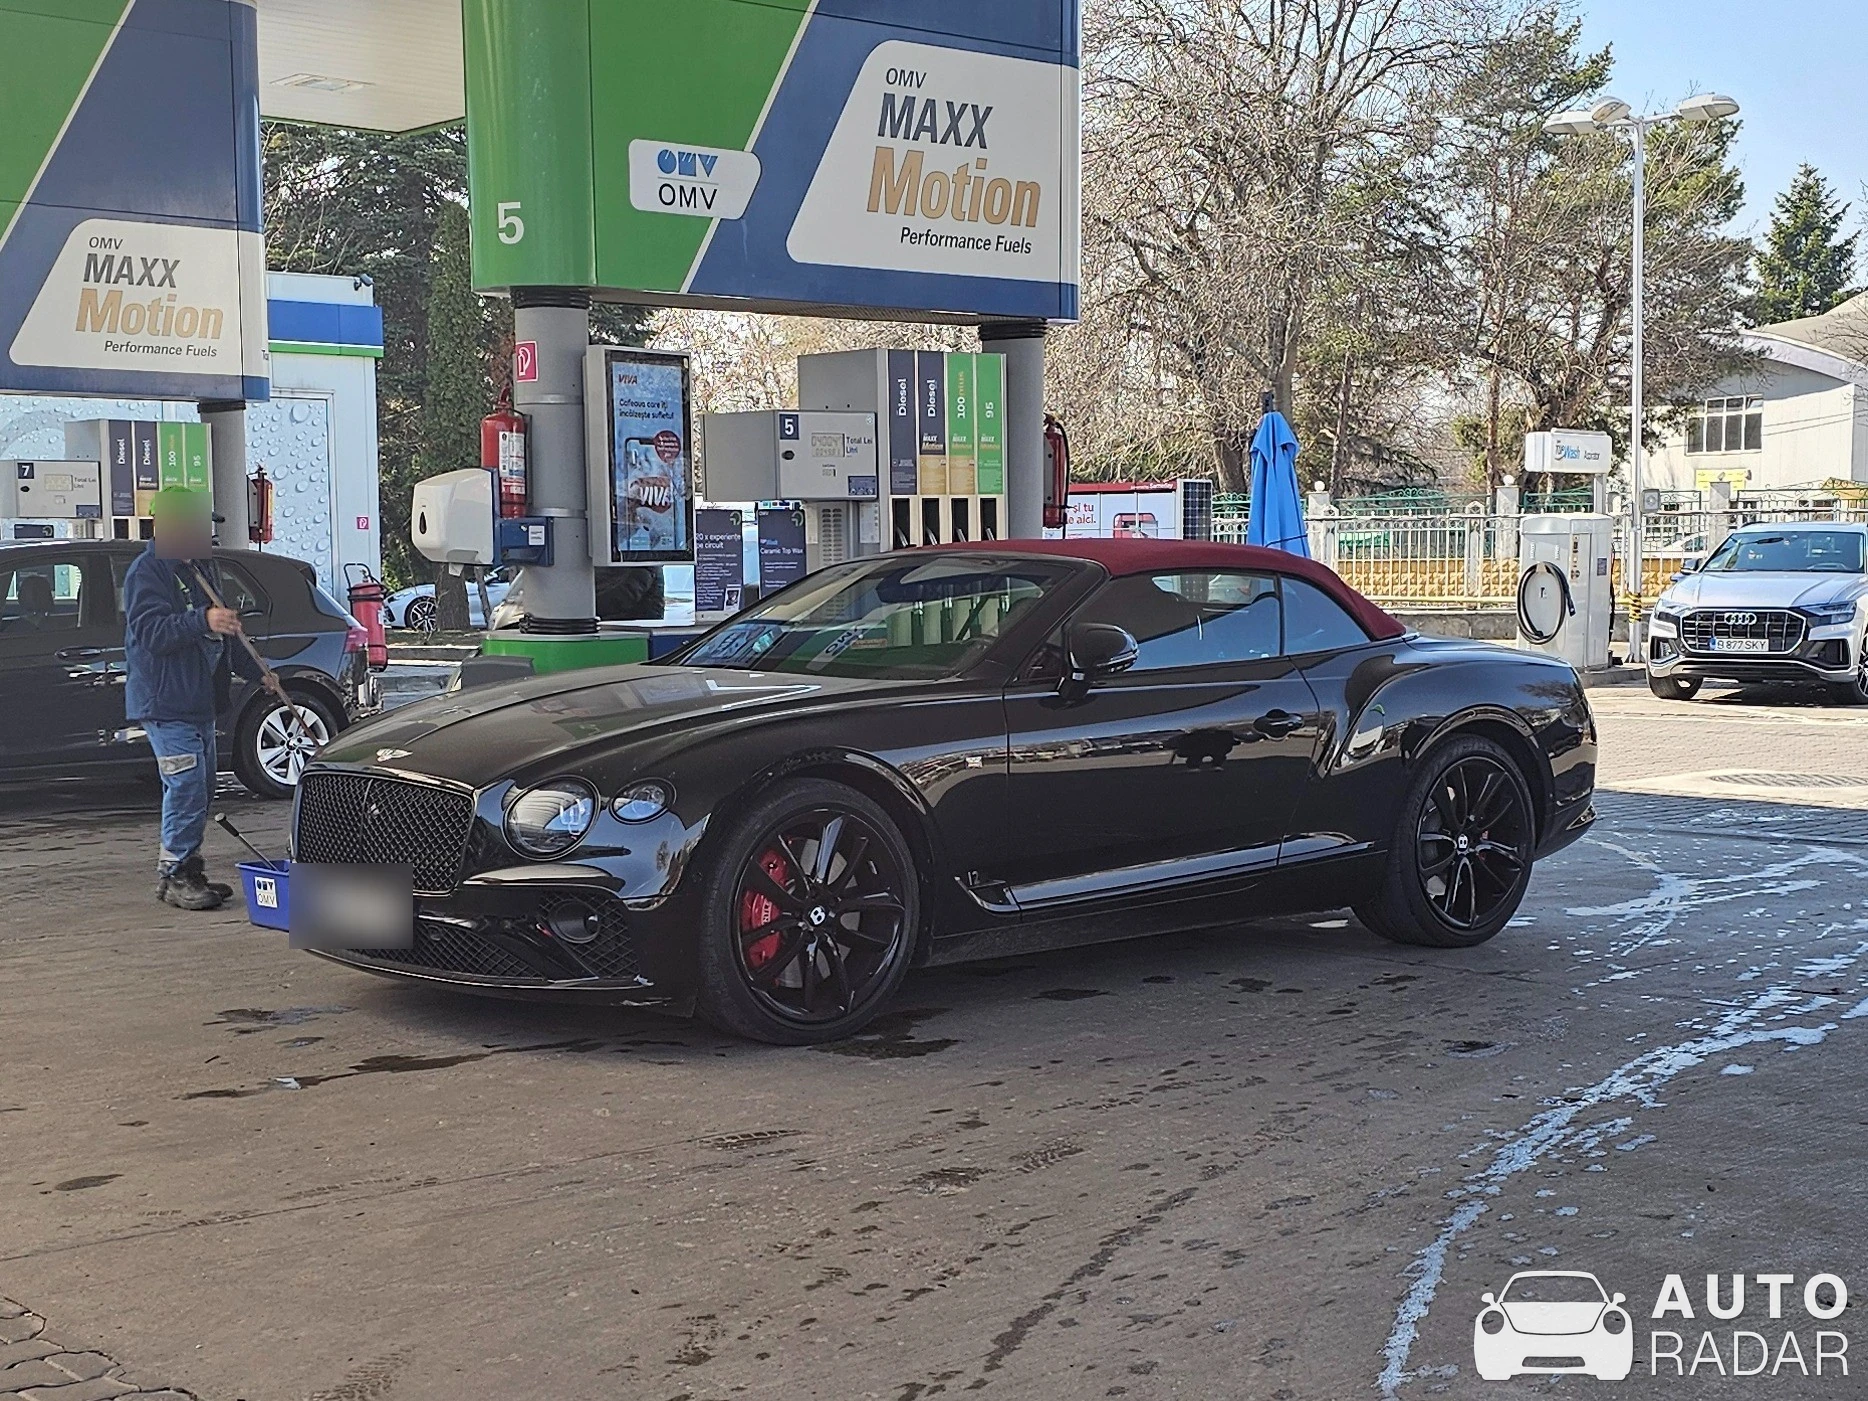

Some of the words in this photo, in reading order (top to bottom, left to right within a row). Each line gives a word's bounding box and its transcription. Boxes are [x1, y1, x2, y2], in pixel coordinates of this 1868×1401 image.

[886, 67, 927, 89] OMV
[877, 92, 994, 150] MAXX
[658, 183, 718, 210] OMV
[866, 145, 1042, 228] Motion
[497, 201, 525, 245] 5
[89, 236, 124, 250] OMV
[900, 226, 992, 251] Performance
[995, 235, 1033, 254] Fuels
[83, 252, 181, 289] MAXX
[75, 287, 224, 340] Motion
[104, 340, 183, 356] Performance
[185, 344, 218, 358] Fuels
[618, 373, 638, 385] VIVA
[897, 378, 907, 416] Diesel
[926, 379, 936, 417] Diesel
[985, 401, 994, 418] 95
[784, 418, 794, 435] 5
[846, 436, 862, 444] Total
[863, 436, 873, 444] Lei
[117, 438, 126, 465] Diesel
[143, 439, 151, 465] Diesel
[193, 455, 201, 467] 95
[21, 465, 30, 477] 7
[1084, 502, 1095, 513] tu
[705, 541, 724, 549] circuit
[760, 546, 781, 554] Ceramic
[1726, 640, 1744, 650] 877
[1745, 640, 1766, 650] SKY
